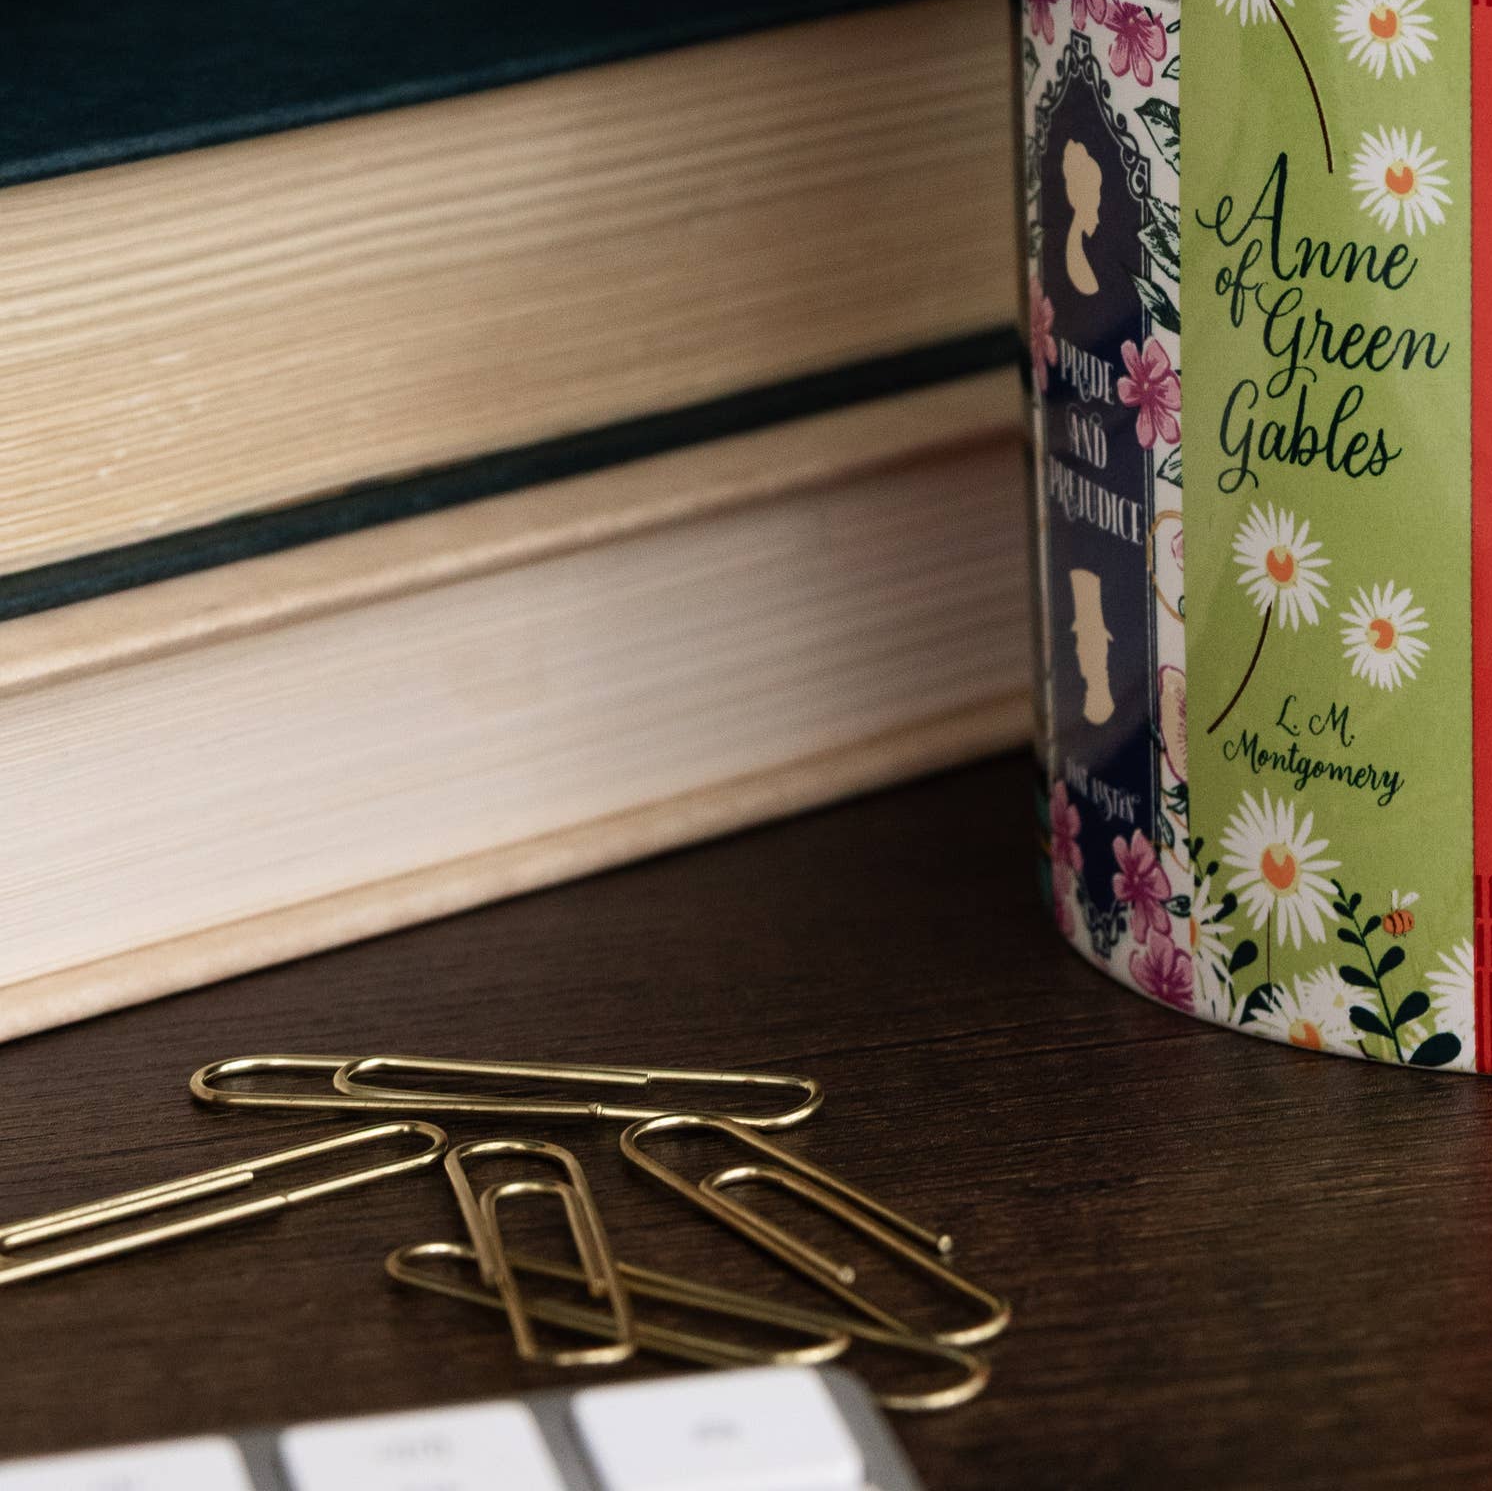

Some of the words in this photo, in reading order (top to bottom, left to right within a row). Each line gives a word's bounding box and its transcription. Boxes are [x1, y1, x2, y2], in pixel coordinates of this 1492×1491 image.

[1196, 152, 1419, 291] Anne
[1215, 238, 1263, 328] of
[1060, 337, 1115, 405] PRIDE
[1255, 282, 1450, 399] Green
[1066, 403, 1107, 469] AND
[1218, 379, 1402, 494] Gables
[1275, 694, 1300, 737] L.
[1308, 702, 1355, 747] M.
[1223, 729, 1405, 807] Montgomery
